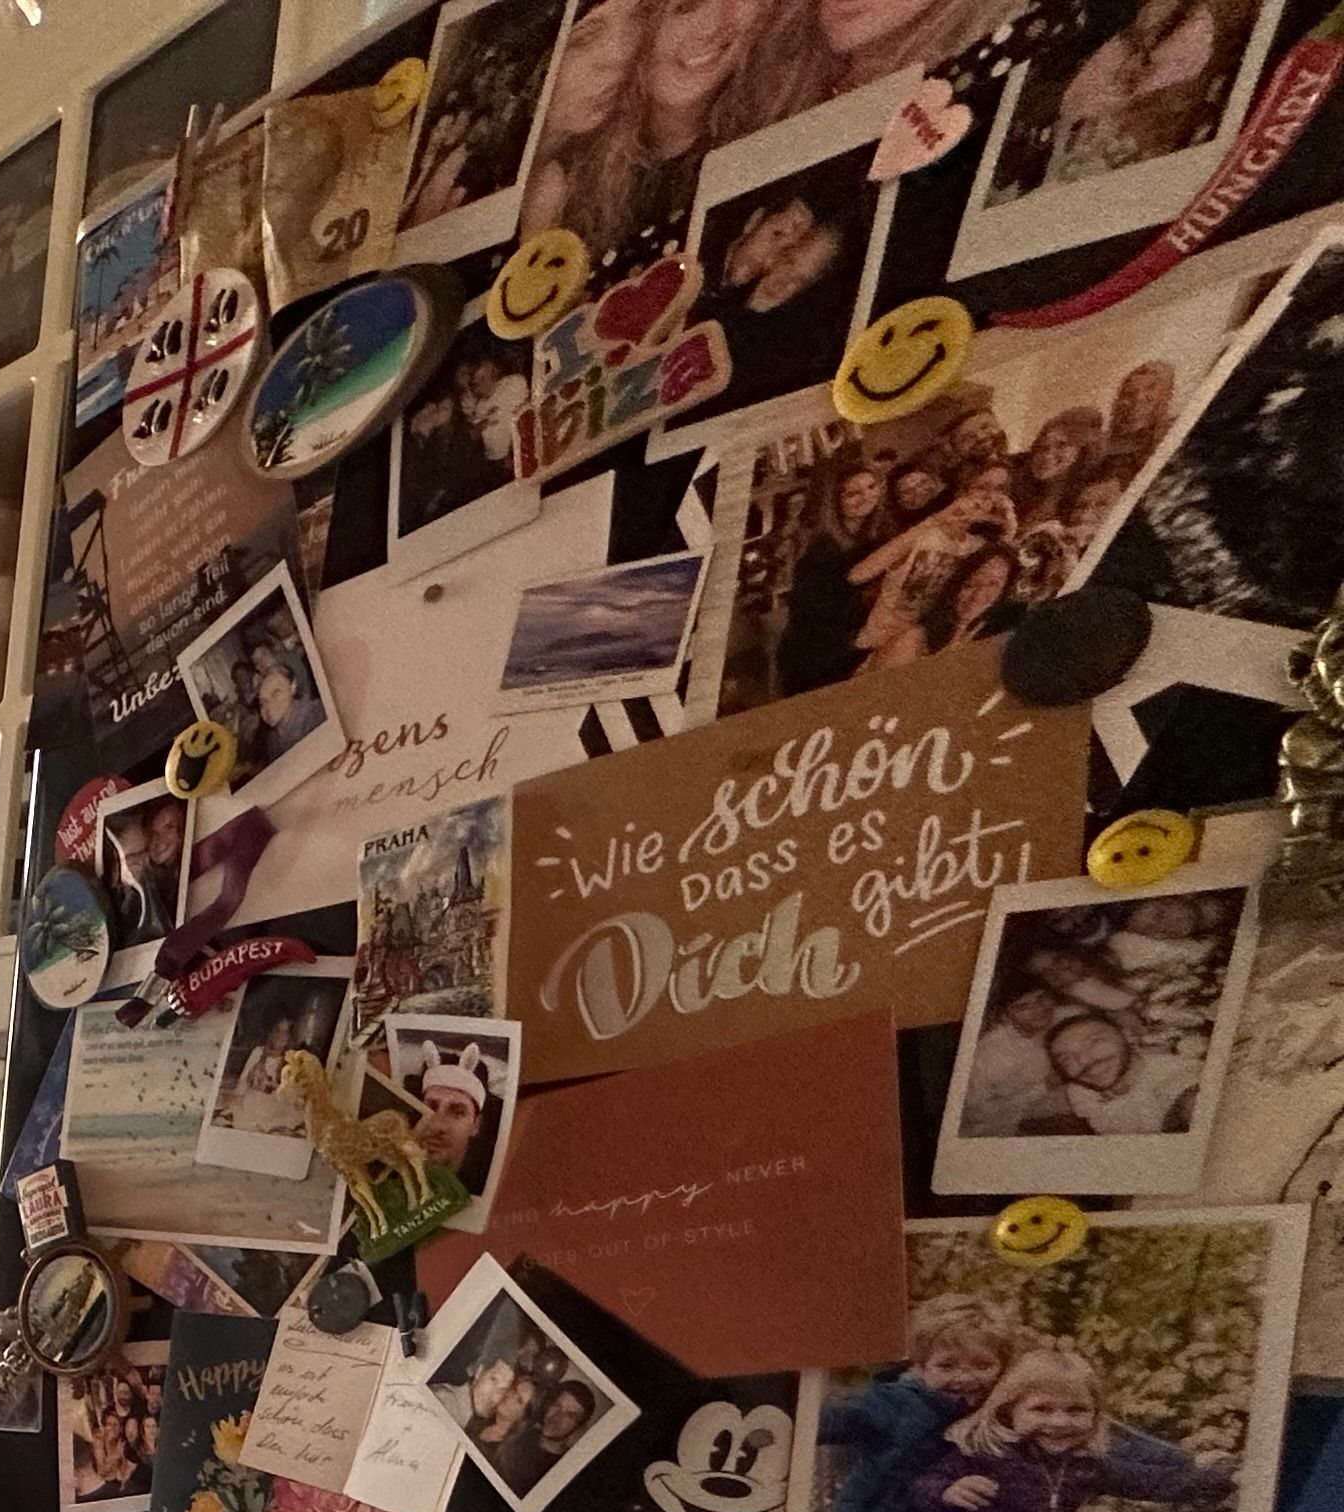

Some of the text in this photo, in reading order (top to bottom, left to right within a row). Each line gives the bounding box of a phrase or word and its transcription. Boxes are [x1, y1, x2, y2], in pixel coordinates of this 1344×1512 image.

[1165, 68, 1334, 253] HUNGARY
[315, 207, 371, 264] 20
[327, 712, 449, 779] zens
[678, 716, 975, 864] schön
[362, 824, 431, 858] PRAHA
[827, 809, 887, 865] es
[187, 940, 284, 993] BUDAPEST
[538, 891, 862, 1042] Dich
[21, 1190, 63, 1220] LAURA
[548, 1181, 714, 1221] happy
[725, 1155, 807, 1185] NEVER
[392, 1197, 452, 1238] TANZANIA
[683, 1218, 755, 1245] STYLE
[175, 1357, 268, 1401] Happy
